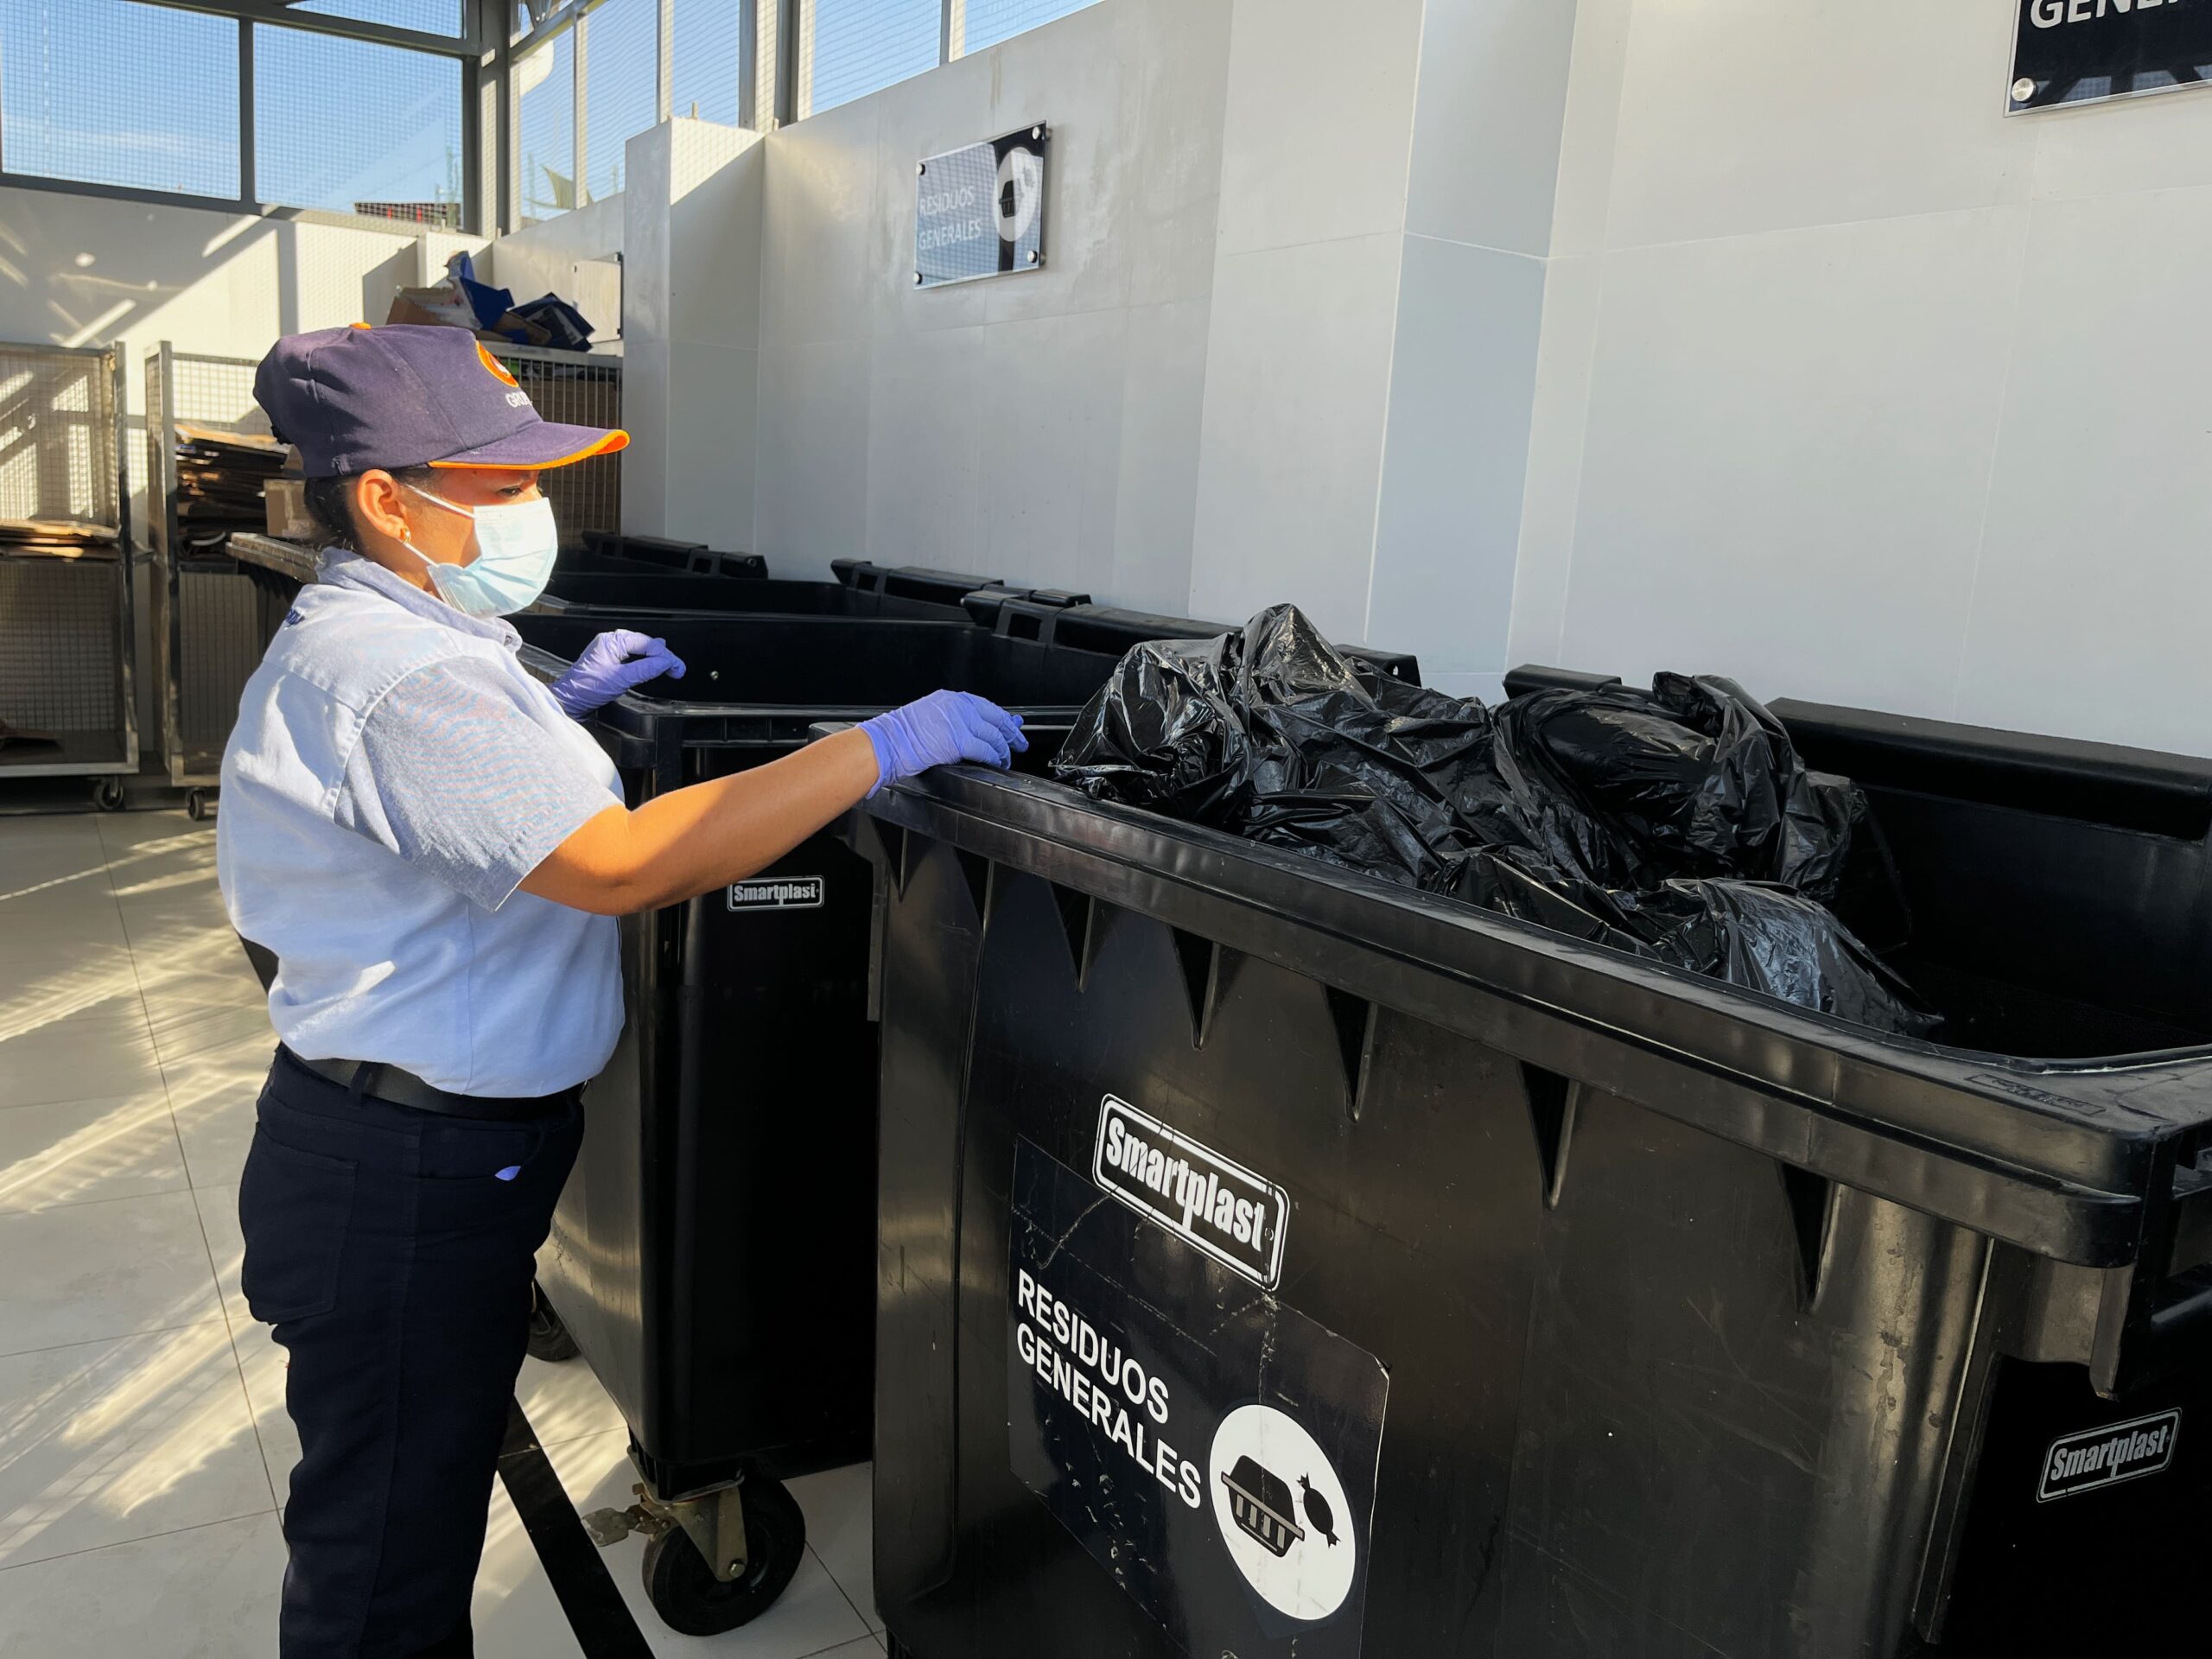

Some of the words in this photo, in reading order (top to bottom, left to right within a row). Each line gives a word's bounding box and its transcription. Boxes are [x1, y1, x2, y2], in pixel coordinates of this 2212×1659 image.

[918, 219, 982, 251] GENERALES
[919, 185, 976, 216] RESIDUOS
[1106, 1116, 1265, 1252] Smartplast
[1018, 1268, 1169, 1424] RESIDUOS
[1017, 1322, 1201, 1509] GENERALES
[2050, 1425, 2169, 1480] Smartplast
